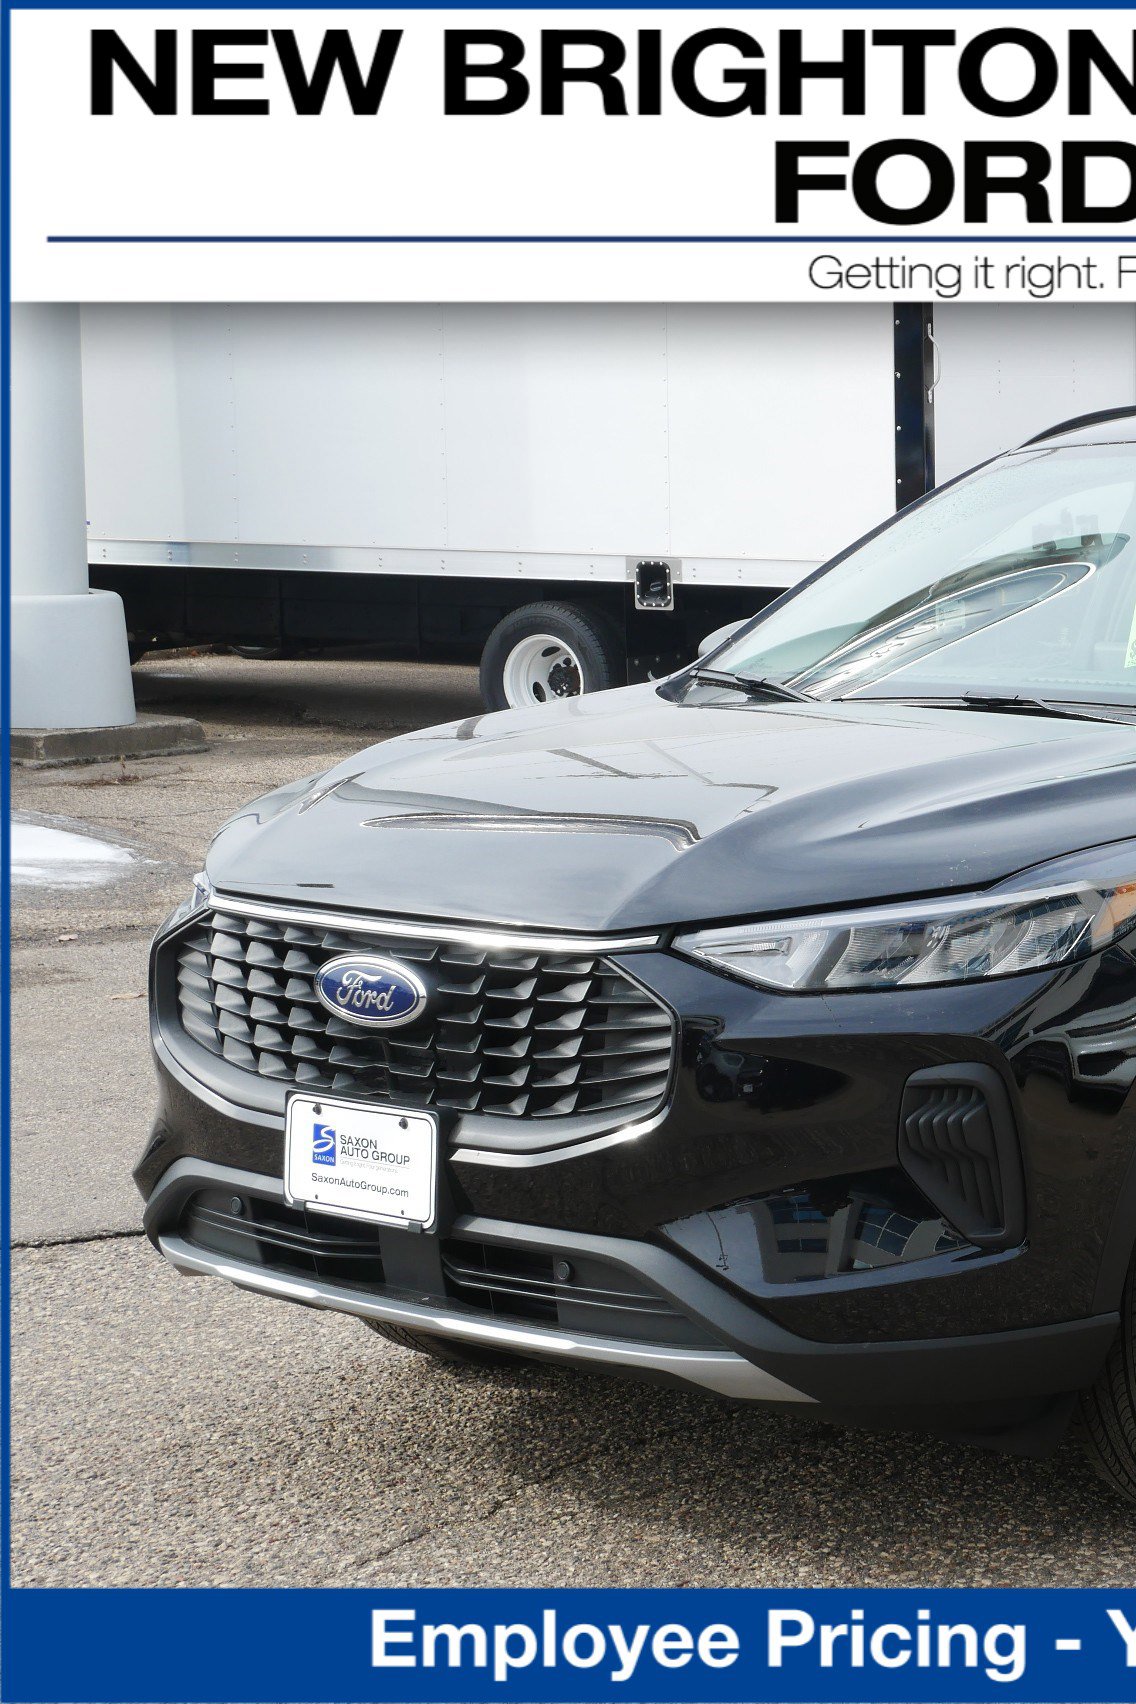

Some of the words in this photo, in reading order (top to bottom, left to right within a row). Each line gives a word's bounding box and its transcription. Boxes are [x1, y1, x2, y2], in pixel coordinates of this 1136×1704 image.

[336, 969, 397, 1012] Ford
[340, 1134, 378, 1150] SAXON
[314, 1153, 335, 1163] SAXON
[340, 1145, 369, 1159] AUTO
[371, 1150, 411, 1165] GROUP
[311, 1172, 409, 1198] SaxonAutoGroup.com
